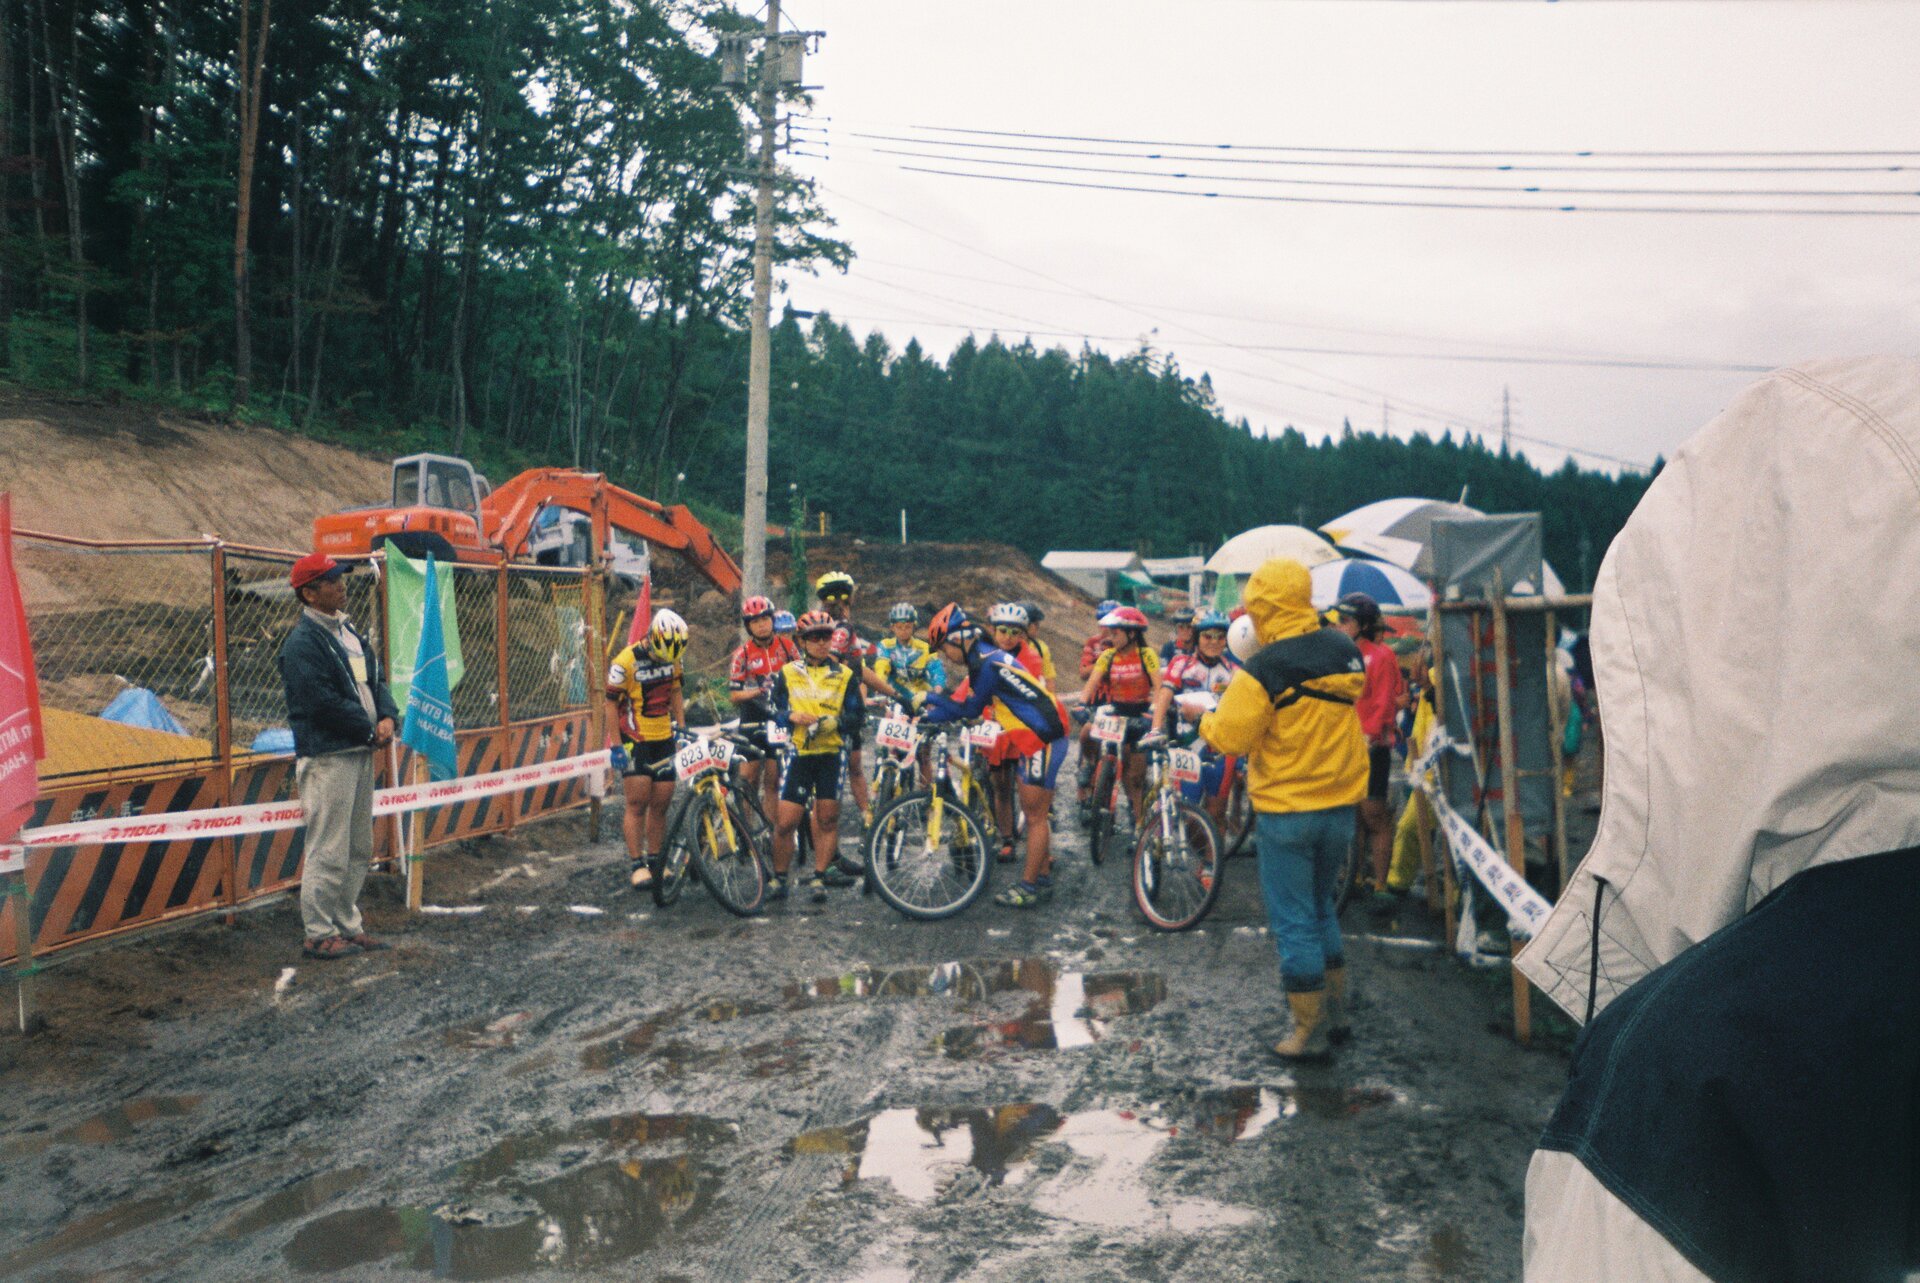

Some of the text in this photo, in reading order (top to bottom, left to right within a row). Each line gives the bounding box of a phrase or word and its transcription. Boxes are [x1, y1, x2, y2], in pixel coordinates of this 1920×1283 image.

[885, 723, 910, 739] 824
[681, 746, 704, 767] 823
[1175, 754, 1195, 770] 821
[390, 792, 417, 804] TIOGA
[202, 815, 243, 829] TIOGA
[122, 823, 167, 838] TIOGA
